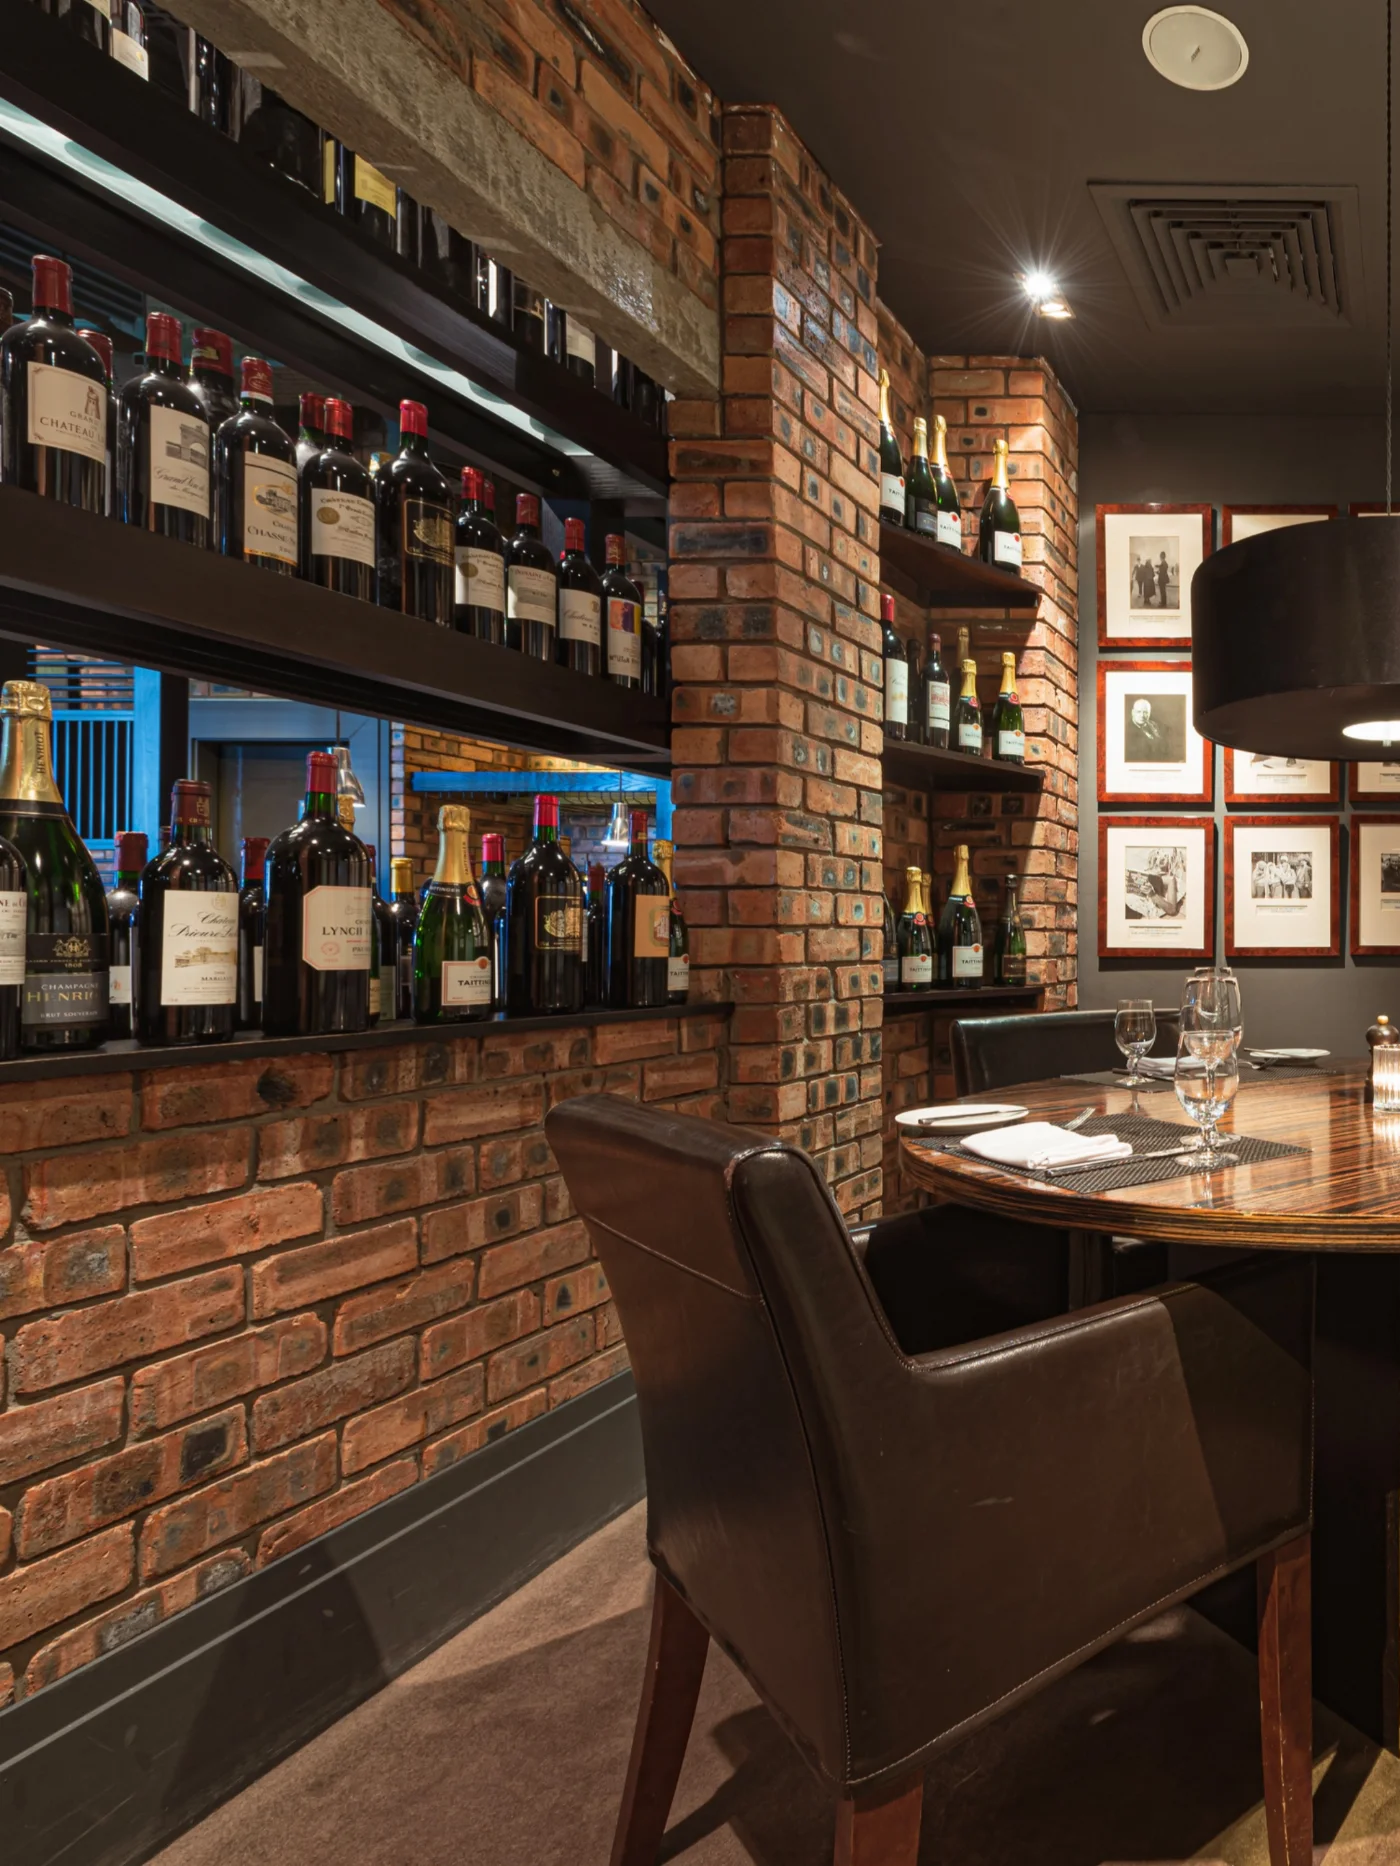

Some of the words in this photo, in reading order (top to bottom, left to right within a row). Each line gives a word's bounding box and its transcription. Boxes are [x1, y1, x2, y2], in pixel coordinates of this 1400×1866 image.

[39, 416, 95, 438] CHATEAU
[35, 731, 46, 774] HENRIOT
[321, 926, 363, 936] LYNCH
[41, 982, 99, 991] CHAMPAGNE
[457, 979, 491, 987] TAITTIN
[41, 1010, 61, 1018] BRUT
